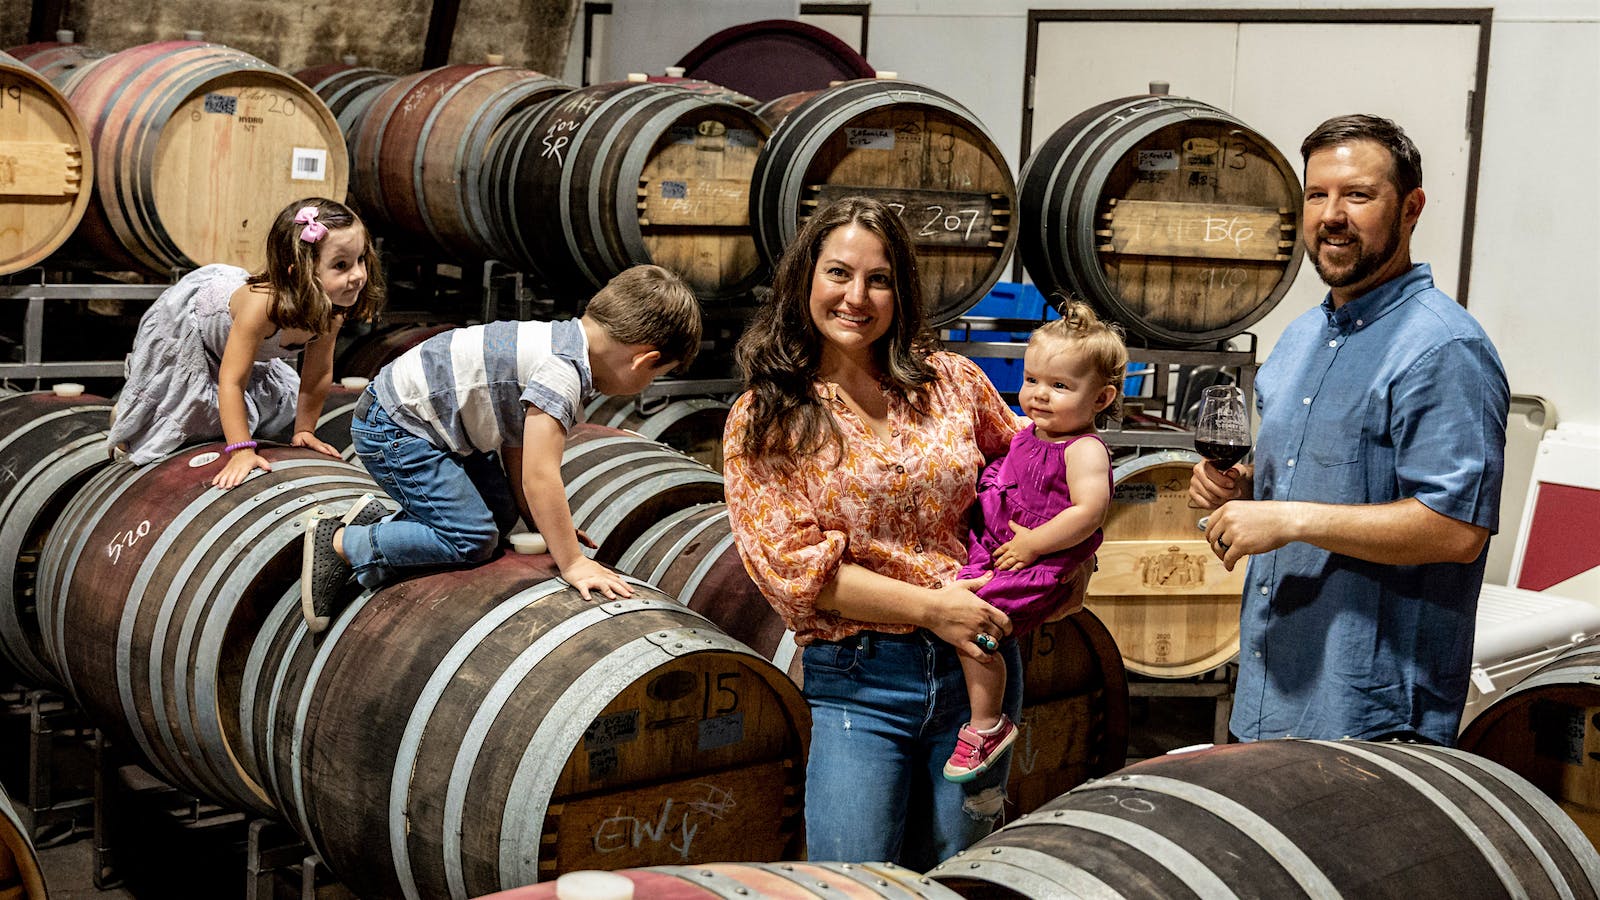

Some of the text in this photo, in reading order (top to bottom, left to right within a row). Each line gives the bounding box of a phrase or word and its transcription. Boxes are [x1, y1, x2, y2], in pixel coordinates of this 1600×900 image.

[268, 94, 296, 117] 20
[541, 136, 569, 169] SR
[1221, 141, 1249, 170] 13
[918, 205, 980, 241] 207
[701, 671, 742, 720] 15
